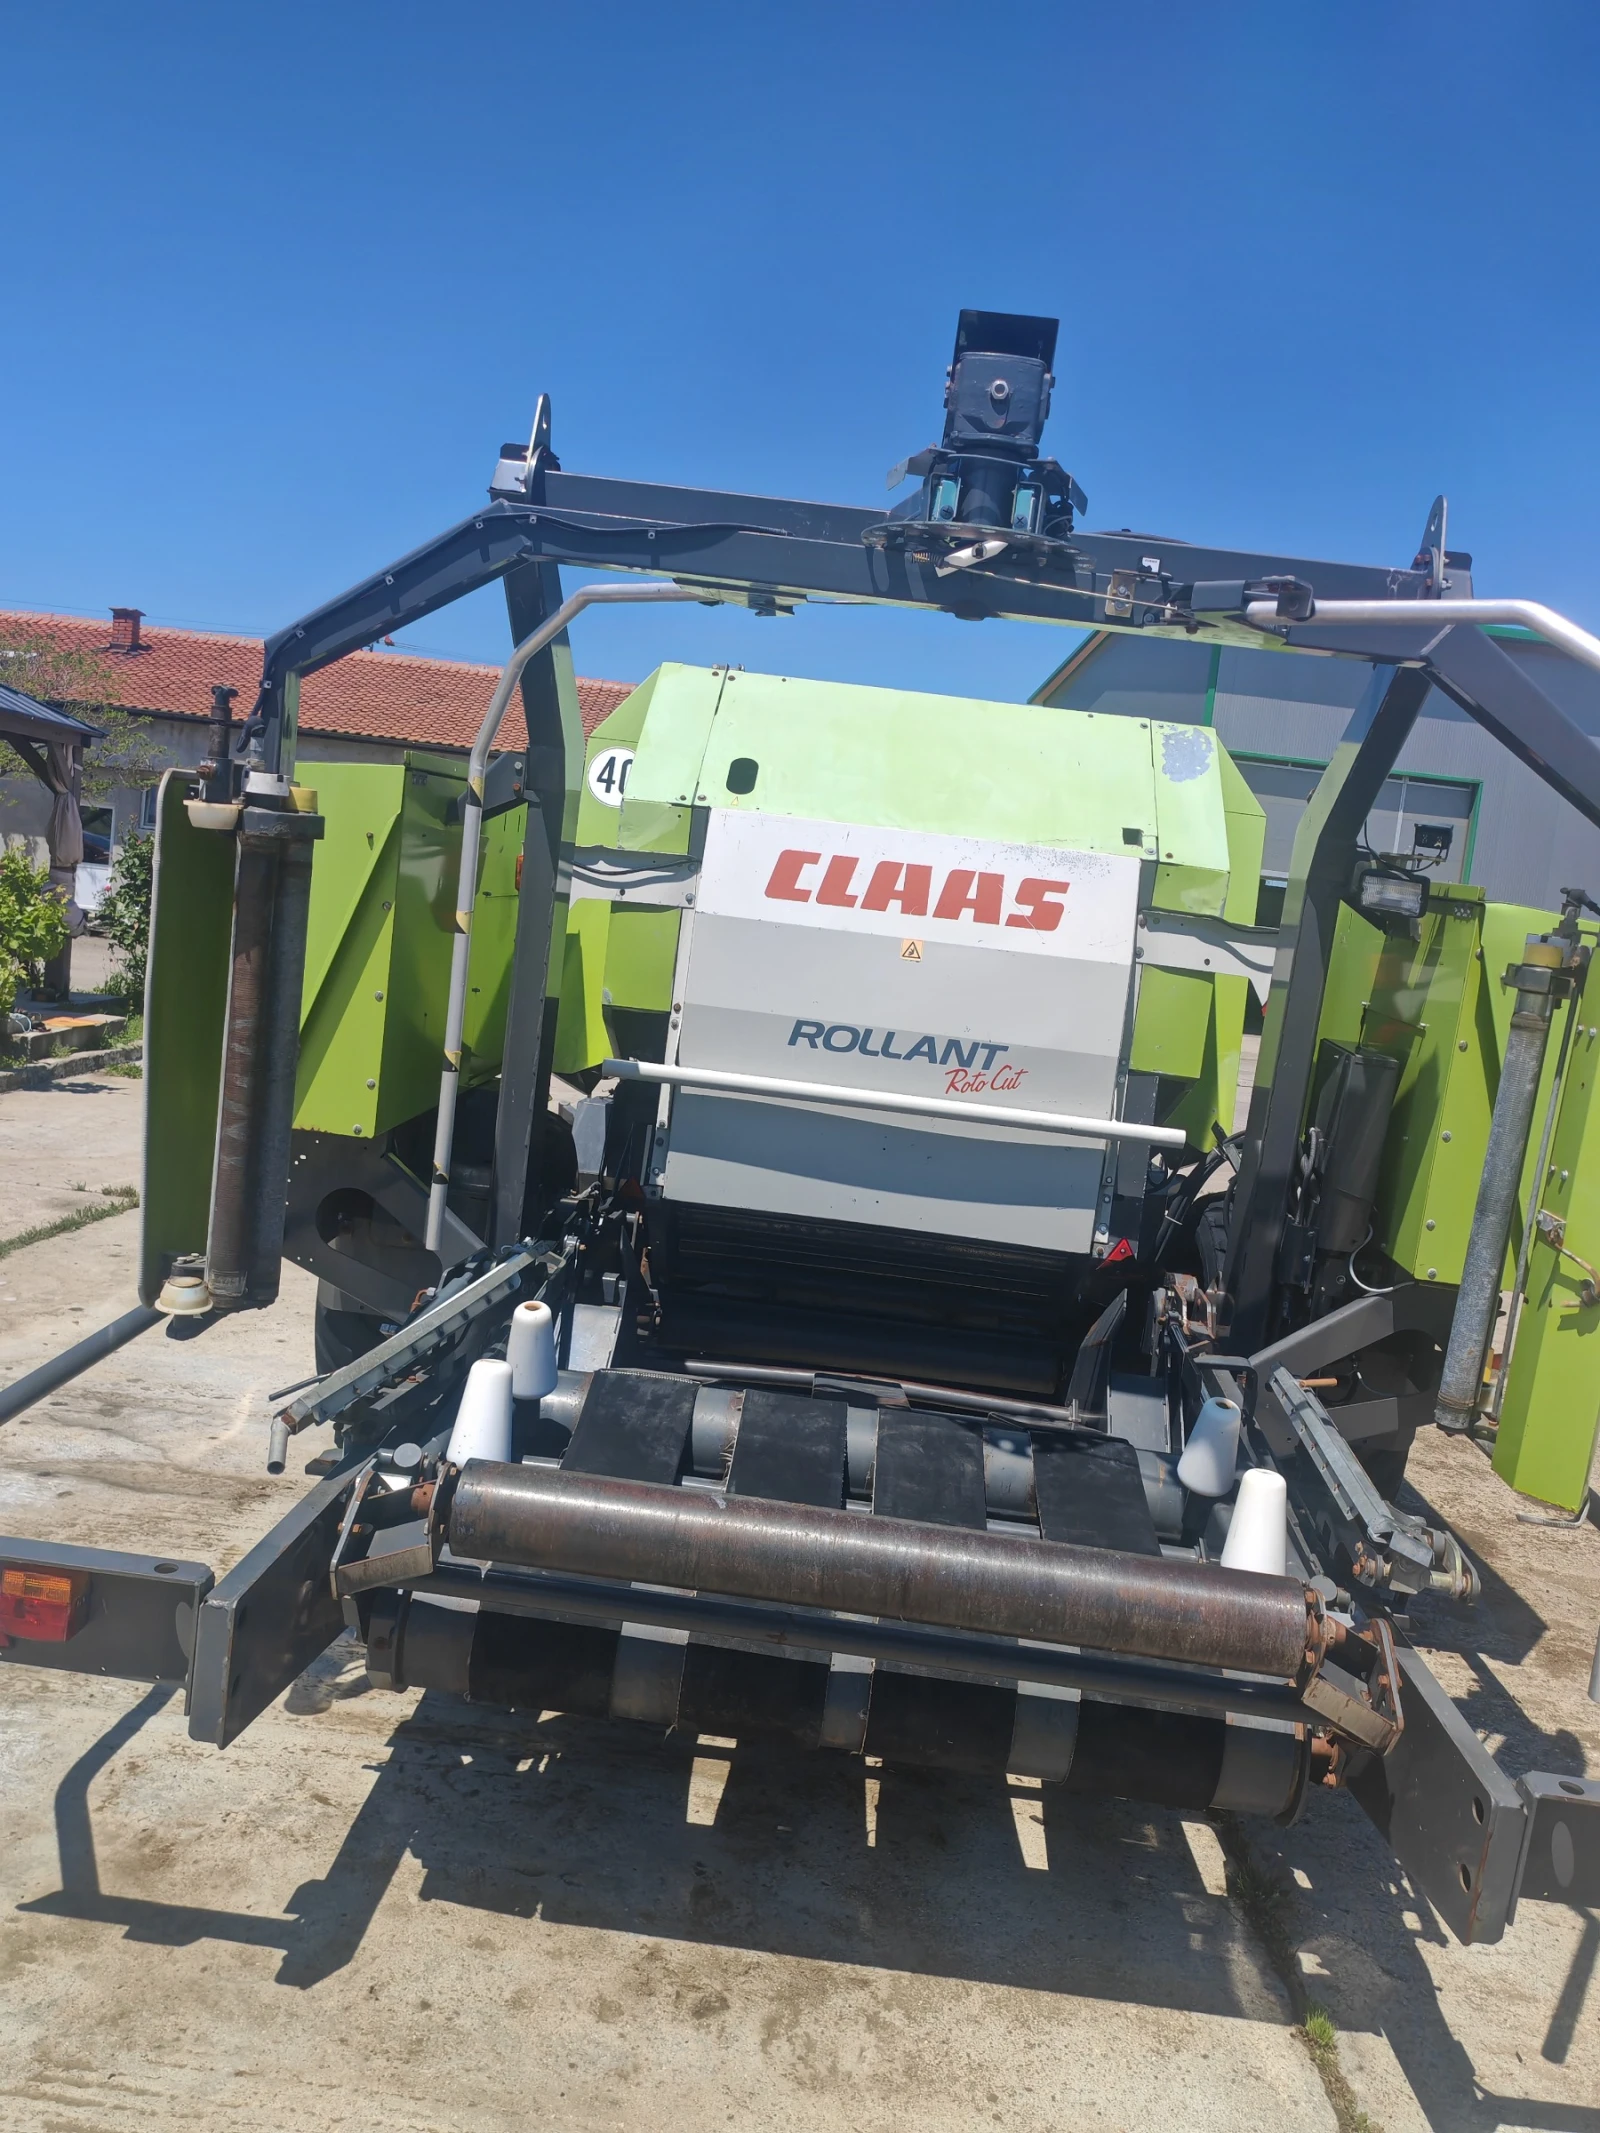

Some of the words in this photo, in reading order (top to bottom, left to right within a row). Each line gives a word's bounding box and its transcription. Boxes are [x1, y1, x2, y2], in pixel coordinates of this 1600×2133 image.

[764, 849, 1071, 932] CLAAS
[787, 1019, 1009, 1071] ROLLANT
[945, 1068, 989, 1095] Roto
[990, 1064, 1029, 1091] Cut
